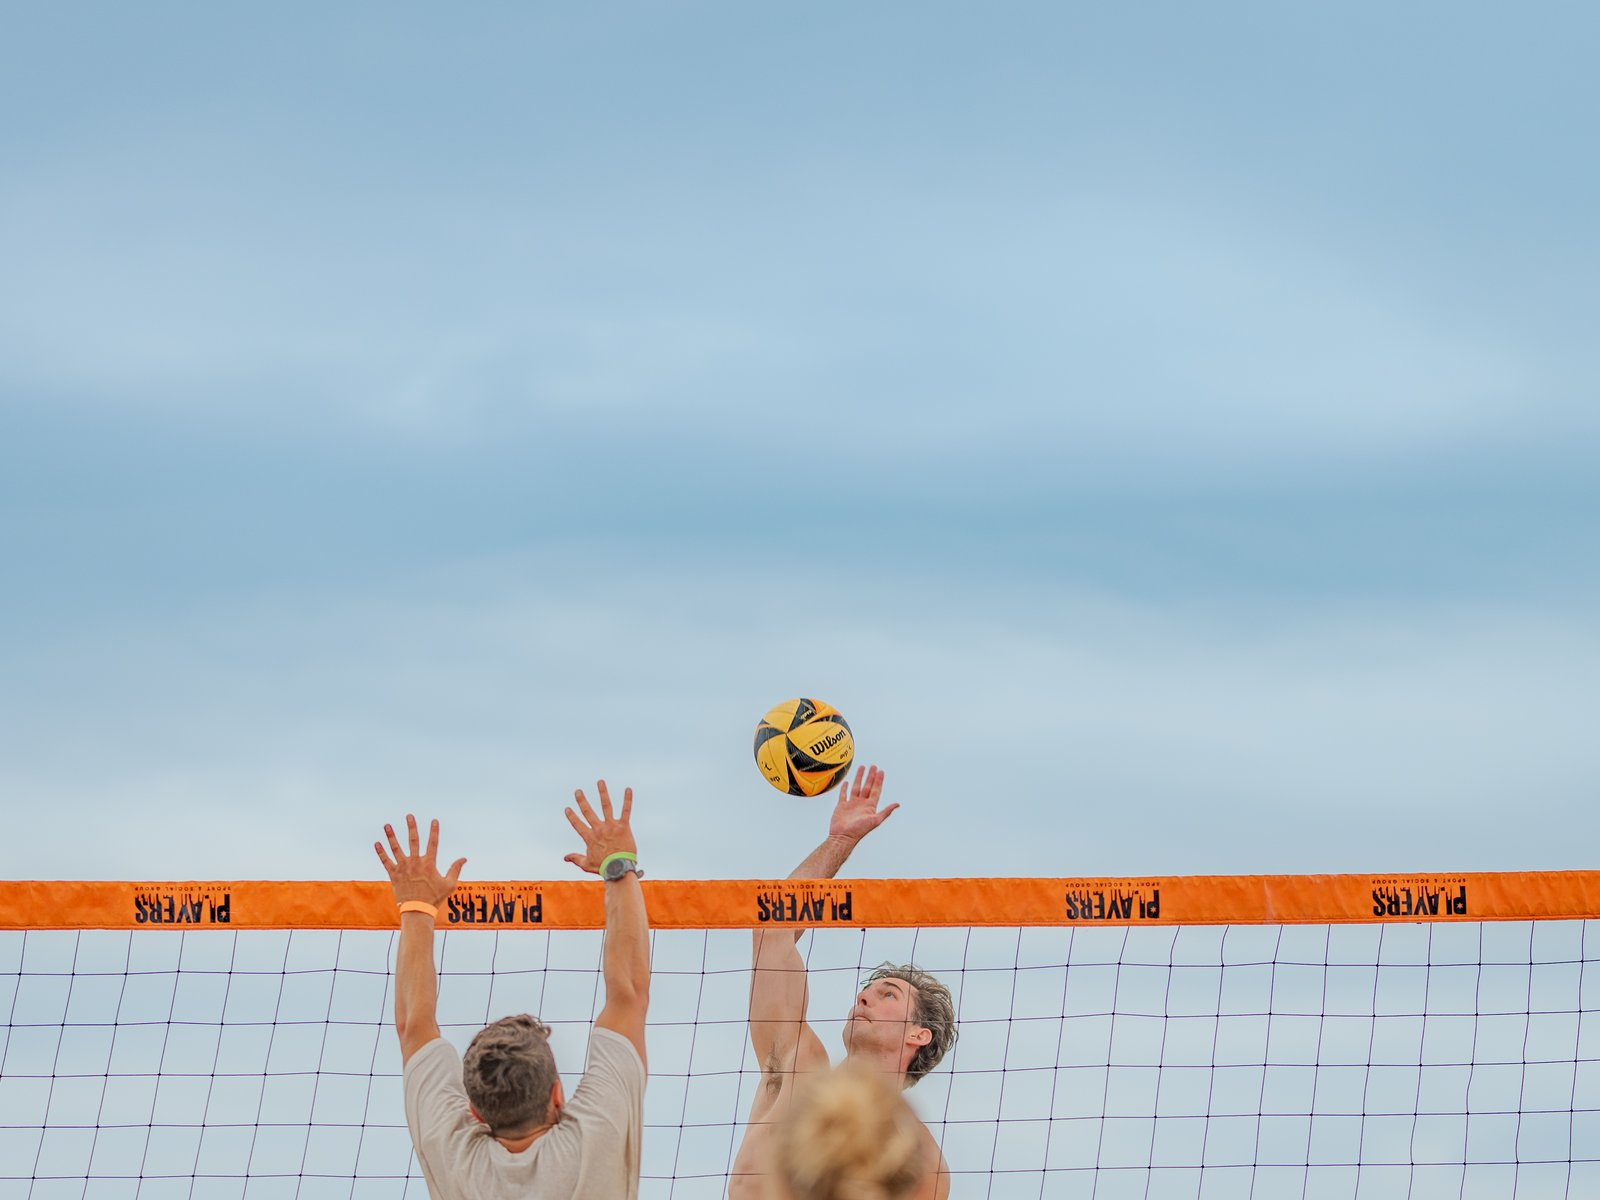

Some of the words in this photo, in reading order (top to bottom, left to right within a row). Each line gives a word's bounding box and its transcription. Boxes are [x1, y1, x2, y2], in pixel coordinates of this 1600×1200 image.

[810, 730, 846, 756] Wilson
[135, 893, 231, 923] PLAYERS
[448, 893, 542, 923] PLAYERS
[757, 891, 852, 921] PLAYERS
[1066, 889, 1160, 919] PLAYERS
[1372, 885, 1467, 916] PLAYERS
